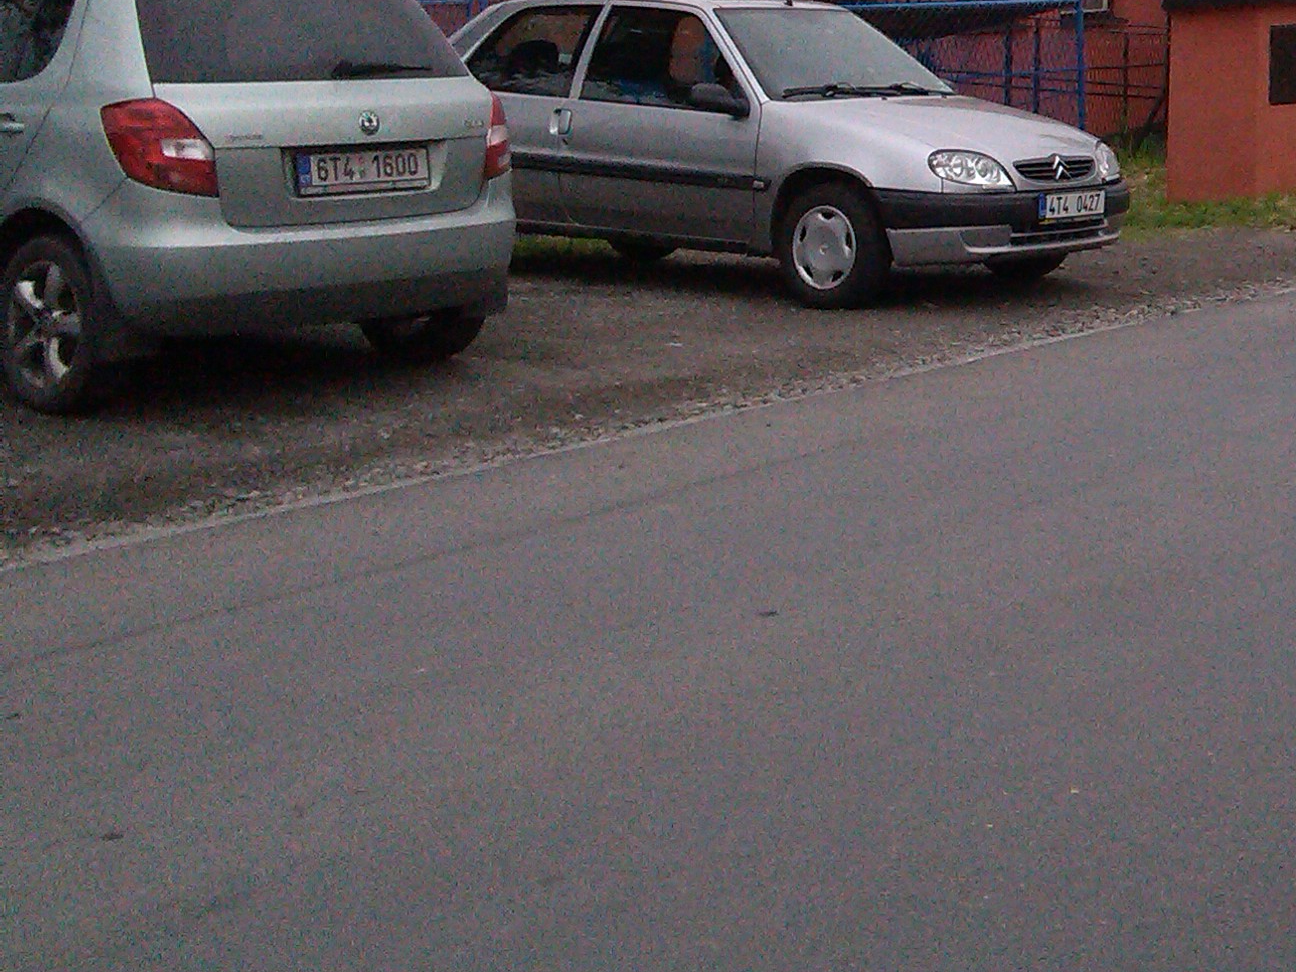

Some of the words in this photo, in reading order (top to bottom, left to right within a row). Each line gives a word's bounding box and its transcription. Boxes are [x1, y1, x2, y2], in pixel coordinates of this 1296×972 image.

[316, 156, 354, 182] 6T4
[371, 152, 419, 178] 1600
[1048, 196, 1069, 215] 4T4
[1076, 193, 1101, 213] 0427
